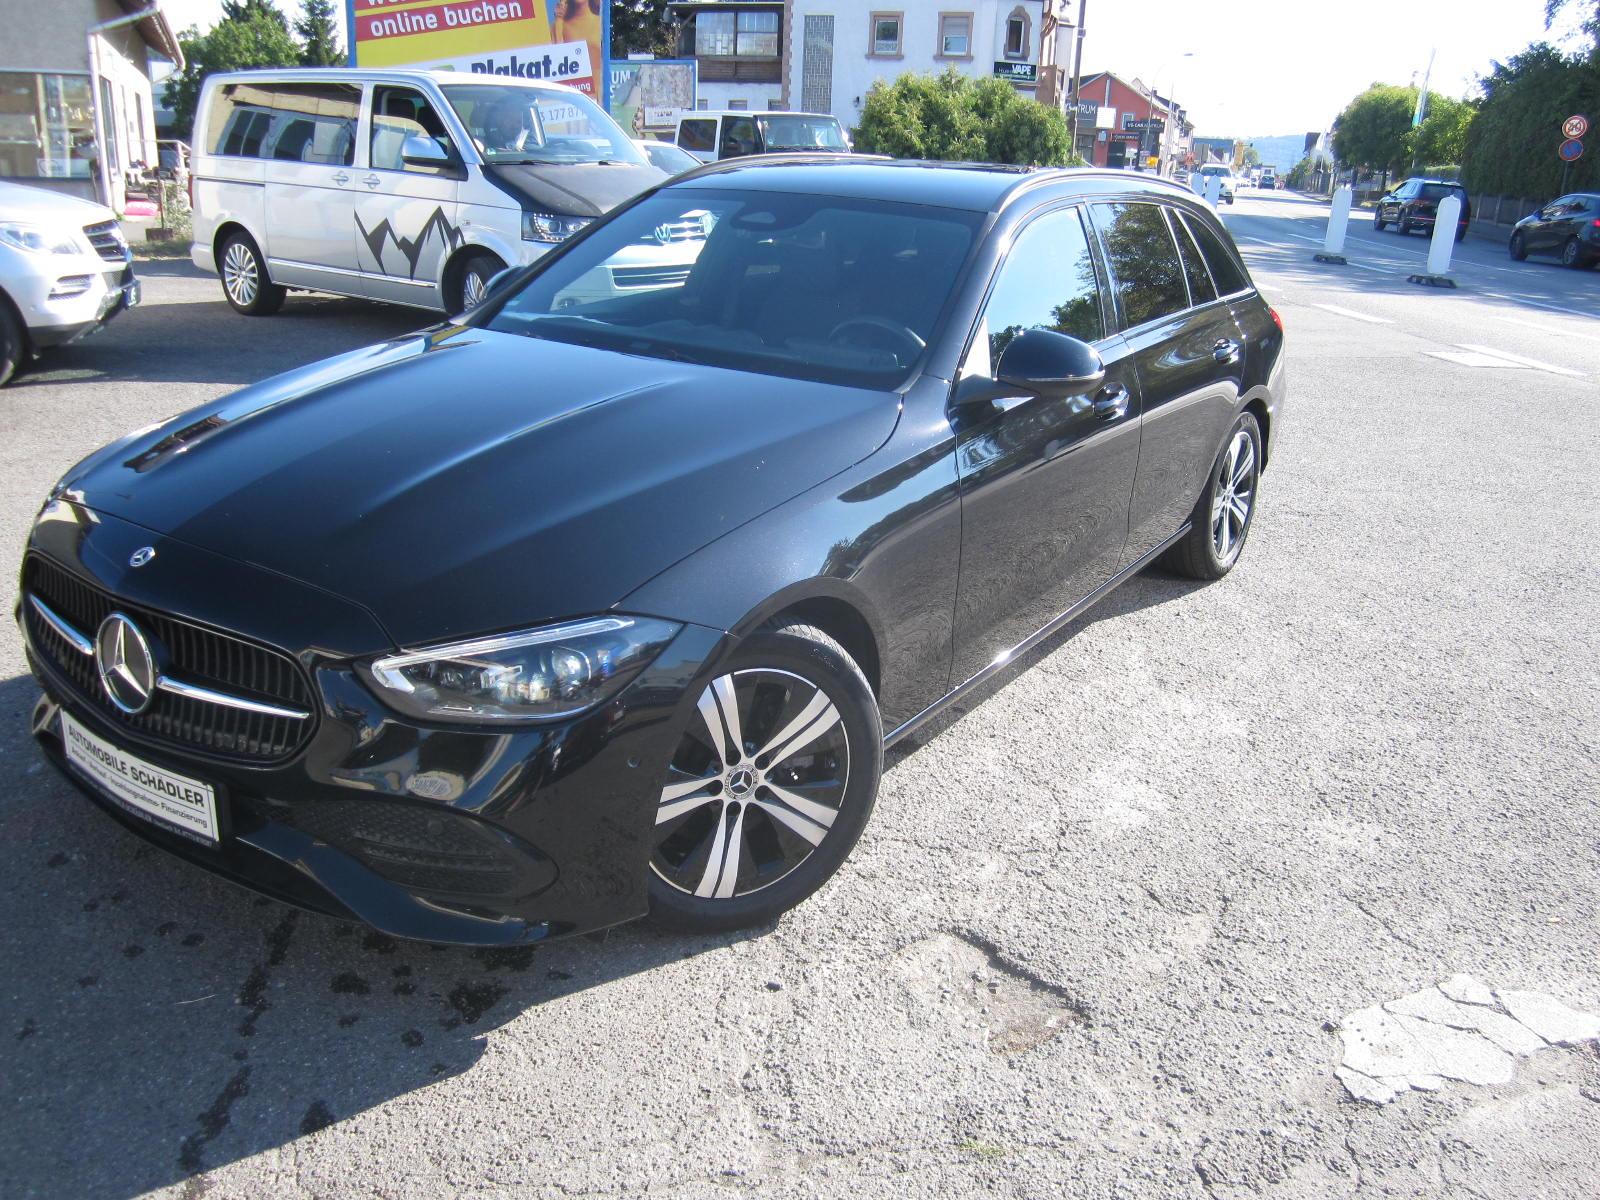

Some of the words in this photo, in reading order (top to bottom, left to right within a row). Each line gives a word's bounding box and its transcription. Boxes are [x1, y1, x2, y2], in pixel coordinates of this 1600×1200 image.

[370, 11, 438, 37] online
[443, 2, 523, 27] buchen
[1011, 64, 1032, 76] VAPE
[68, 724, 128, 776] AUTOMOBILE
[130, 766, 205, 808] SCHÄDLER
[160, 802, 208, 829] Finanzierung
